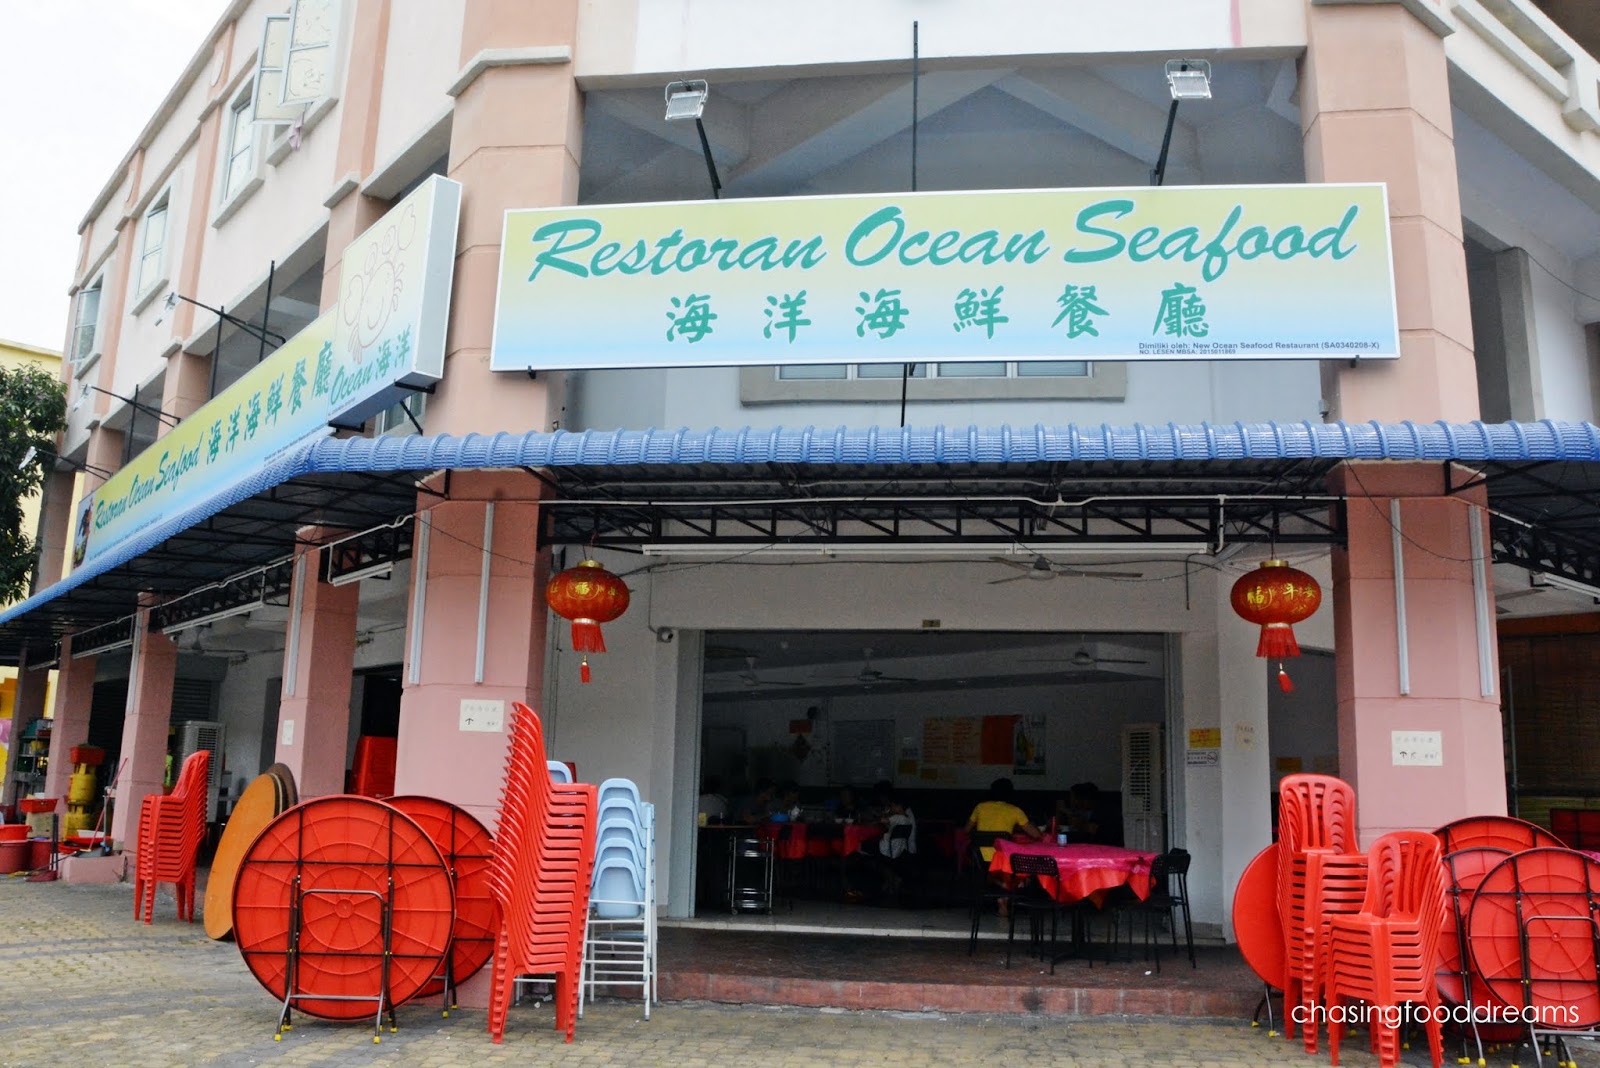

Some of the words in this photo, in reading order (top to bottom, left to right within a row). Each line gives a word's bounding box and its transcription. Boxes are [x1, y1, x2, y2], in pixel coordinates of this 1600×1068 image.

[528, 218, 826, 282] Restoran
[845, 206, 1051, 267] Ocean
[1063, 199, 1359, 283] Seafood
[666, 282, 1210, 344] 海洋海鮮餐廳
[330, 362, 373, 405] Ocean
[375, 324, 411, 380] 海洋
[206, 340, 333, 466] 海洋海鮮餐廳
[128, 473, 155, 508] Ocean
[155, 432, 202, 491] Seafood
